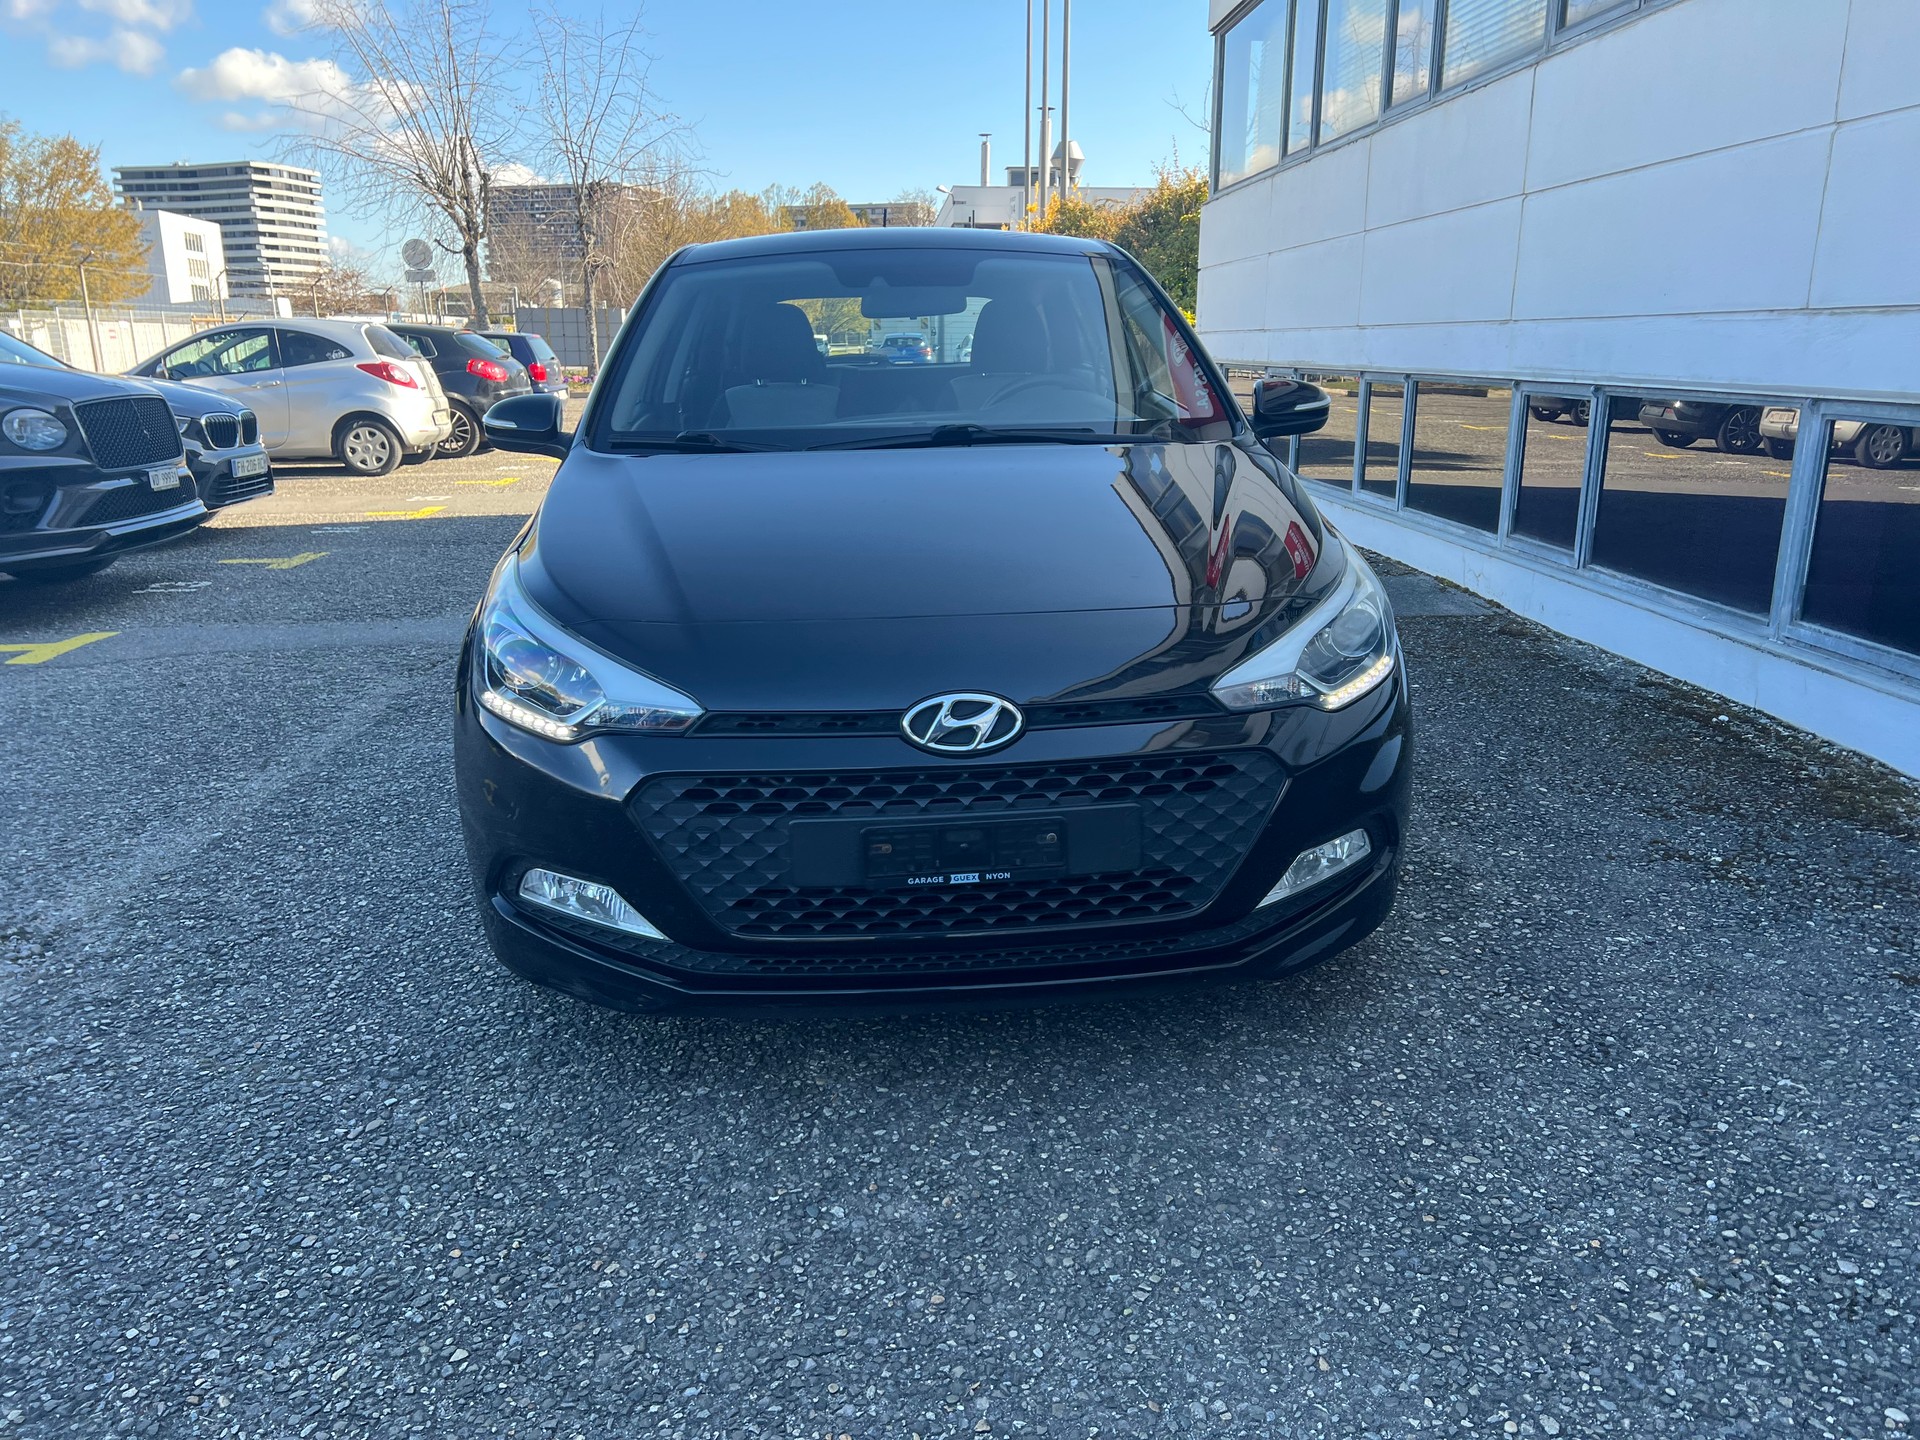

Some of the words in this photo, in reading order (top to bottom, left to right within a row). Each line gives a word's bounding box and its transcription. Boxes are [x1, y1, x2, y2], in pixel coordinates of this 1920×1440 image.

[907, 876, 944, 885] GARAGE
[953, 874, 977, 882] GUEX
[985, 872, 1011, 880] NYON
